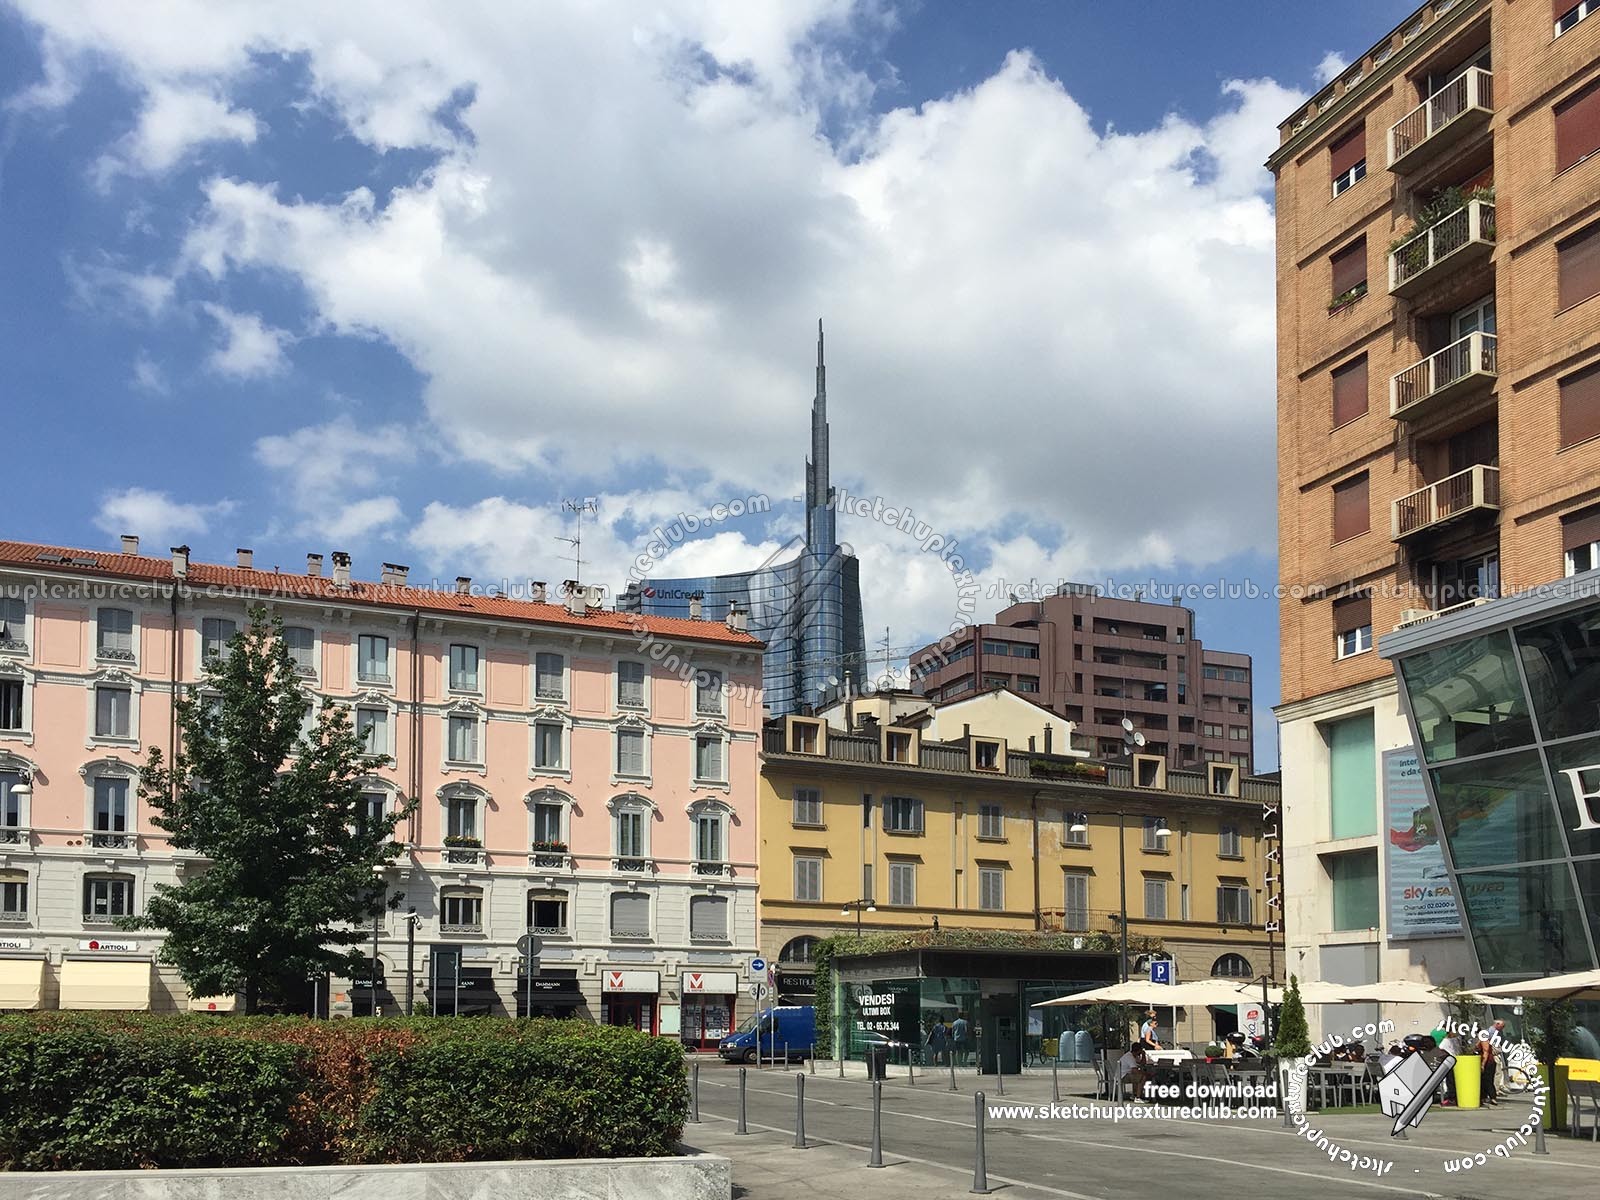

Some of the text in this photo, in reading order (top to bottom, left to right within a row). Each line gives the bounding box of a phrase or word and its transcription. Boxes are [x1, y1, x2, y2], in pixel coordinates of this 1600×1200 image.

[656, 587, 705, 600] UniCredit
[1263, 803, 1279, 933] EATALY
[1157, 965, 1165, 978] P
[858, 993, 895, 1006] VENDESI
[880, 1006, 891, 1016] BOX
